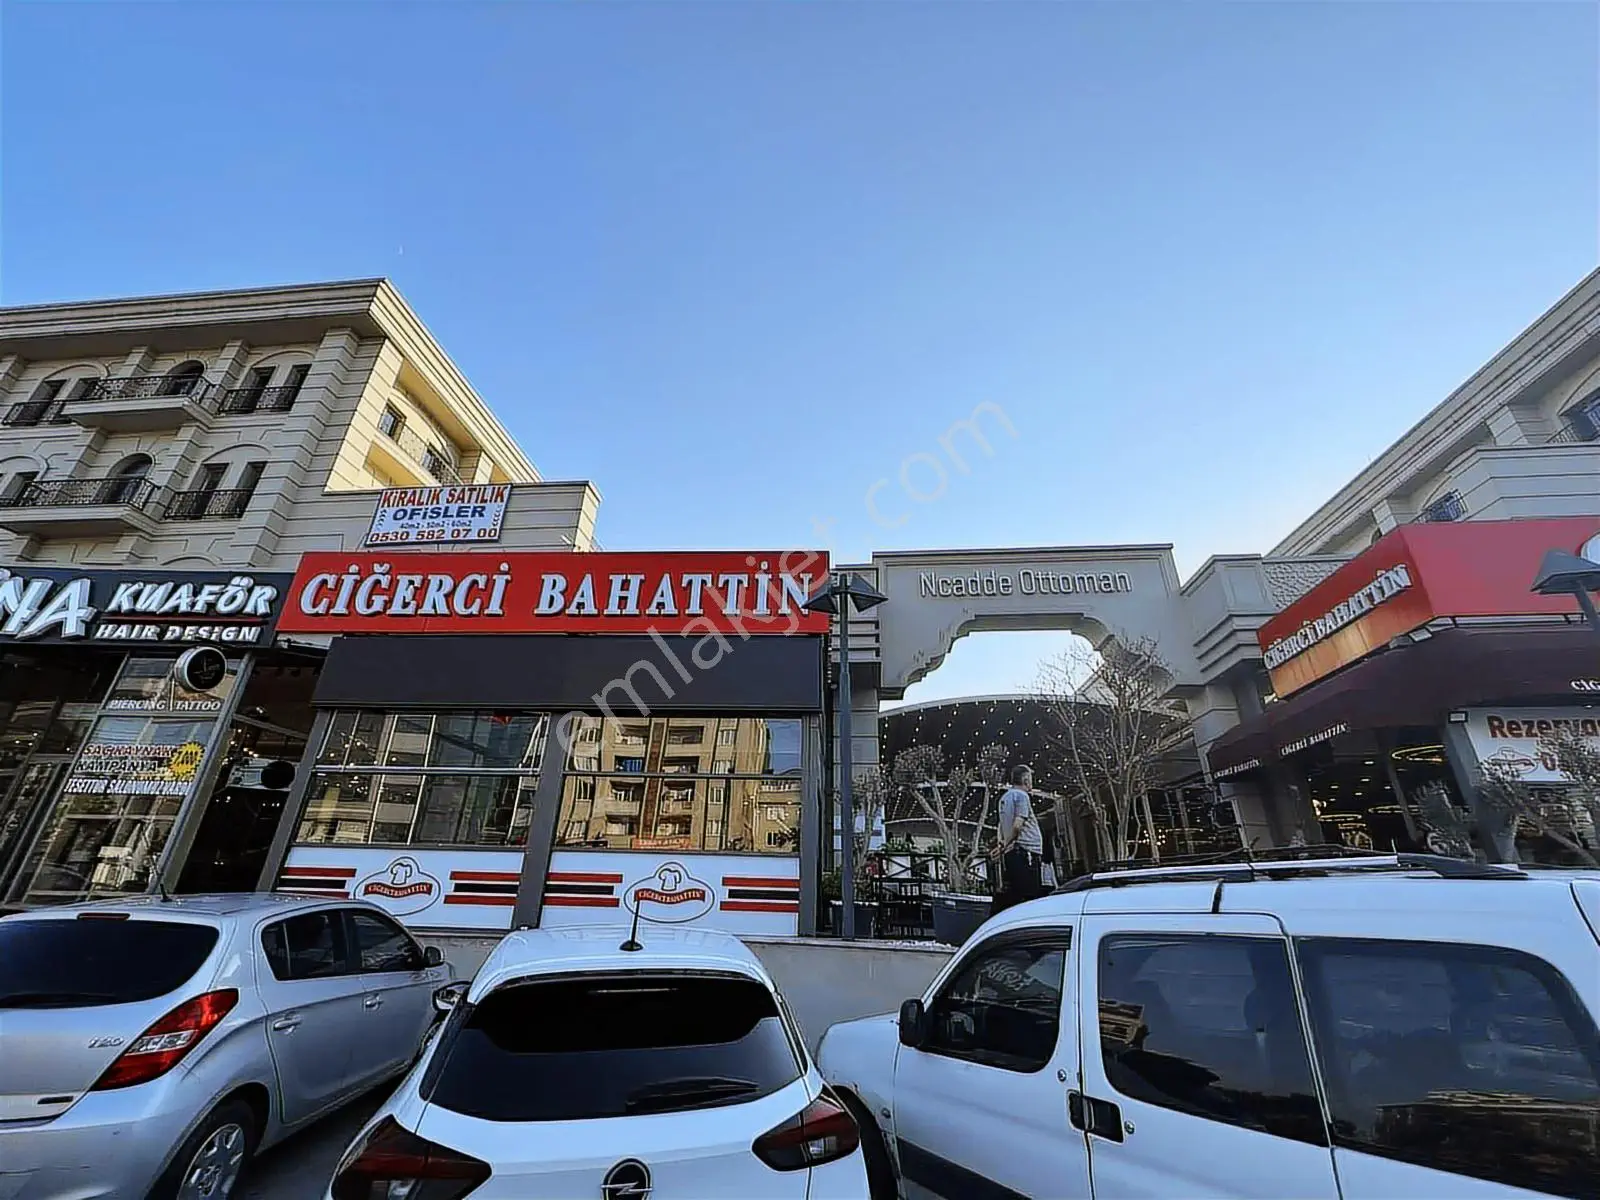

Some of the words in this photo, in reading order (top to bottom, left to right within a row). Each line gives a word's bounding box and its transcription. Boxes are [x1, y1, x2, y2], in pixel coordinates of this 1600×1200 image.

[446, 486, 509, 504] SATILIK
[370, 531, 409, 542] 0530
[415, 529, 445, 540] 582
[451, 528, 471, 538] 07
[477, 528, 497, 538] 00
[300, 562, 511, 616] CİĞERCİ
[534, 561, 812, 616] BAHATTİN
[919, 570, 1012, 598] Ncadde
[1018, 568, 1133, 596] Ottoman
[105, 576, 277, 616] KUAFÖR
[94, 624, 161, 640] HAIR
[175, 700, 221, 711] TATTOO
